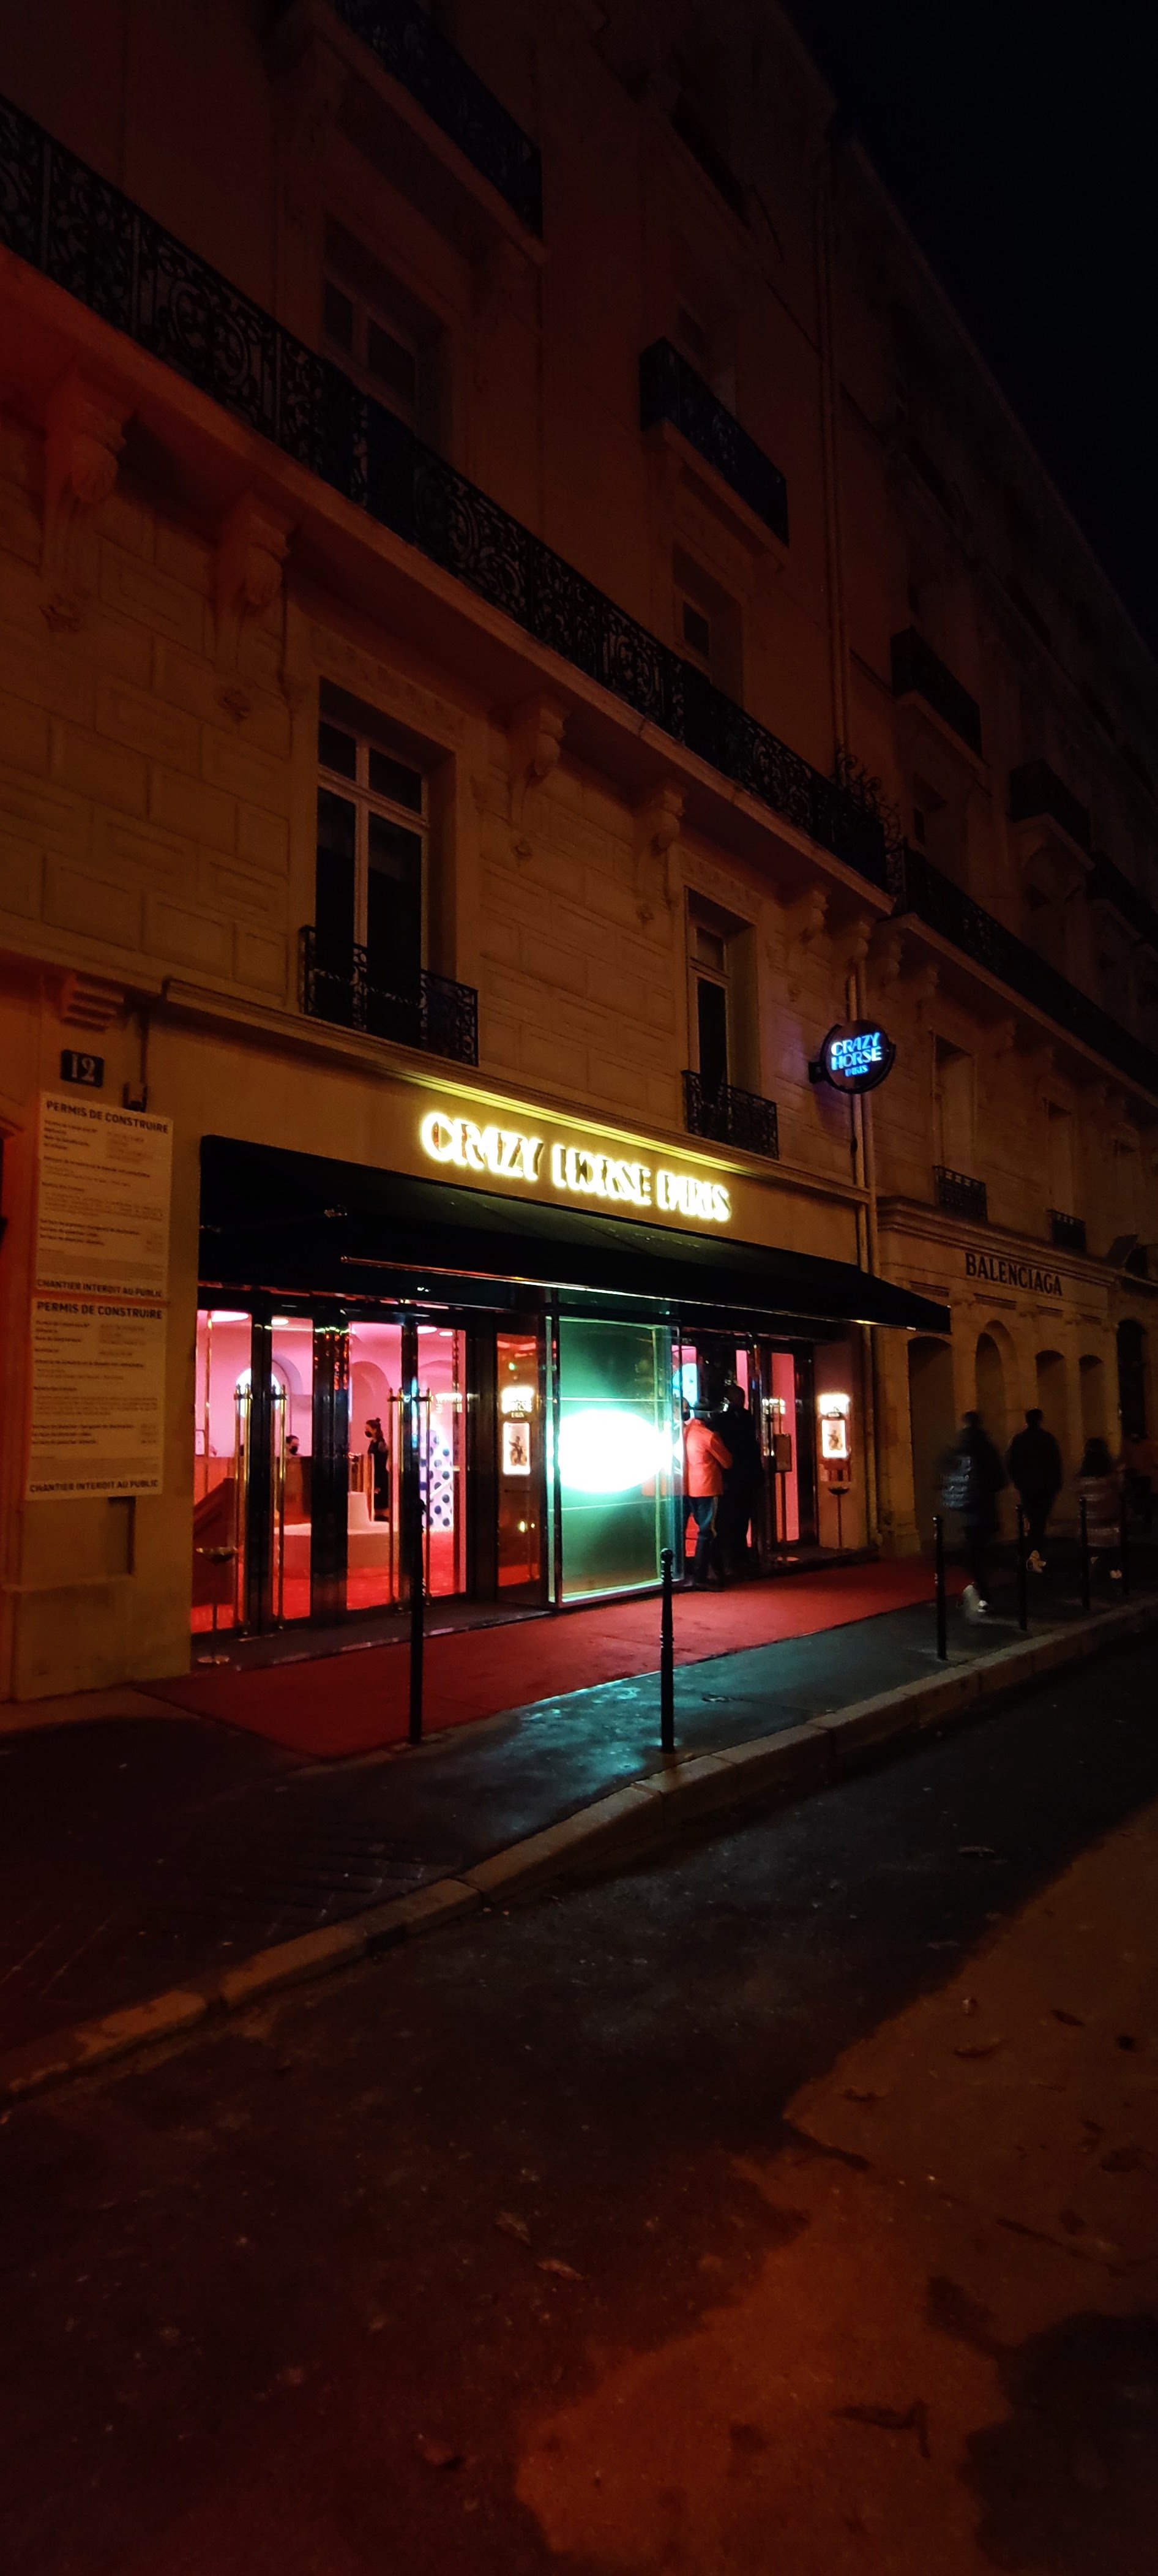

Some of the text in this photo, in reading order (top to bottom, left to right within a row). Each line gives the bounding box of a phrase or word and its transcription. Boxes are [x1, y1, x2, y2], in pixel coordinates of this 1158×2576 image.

[831, 1032, 880, 1056] CRAZY
[71, 1054, 95, 1082] 12
[831, 1046, 883, 1071] HORSE
[46, 1100, 87, 1117] PERMIS
[89, 1109, 103, 1121] DE
[105, 1112, 168, 1134] CONSTRUIRE
[421, 1111, 731, 1221] CRAZY HORSE PARIS
[965, 1252, 1063, 1296] BALENCIAGA
[37, 1279, 162, 1298] CHANTIER INTERDIT AU PUBLIC
[37, 1301, 162, 1319] PERMIS DE CONSTRUIRE
[29, 1479, 159, 1493] CHANTIER INTERDIT AU PUBLIC
